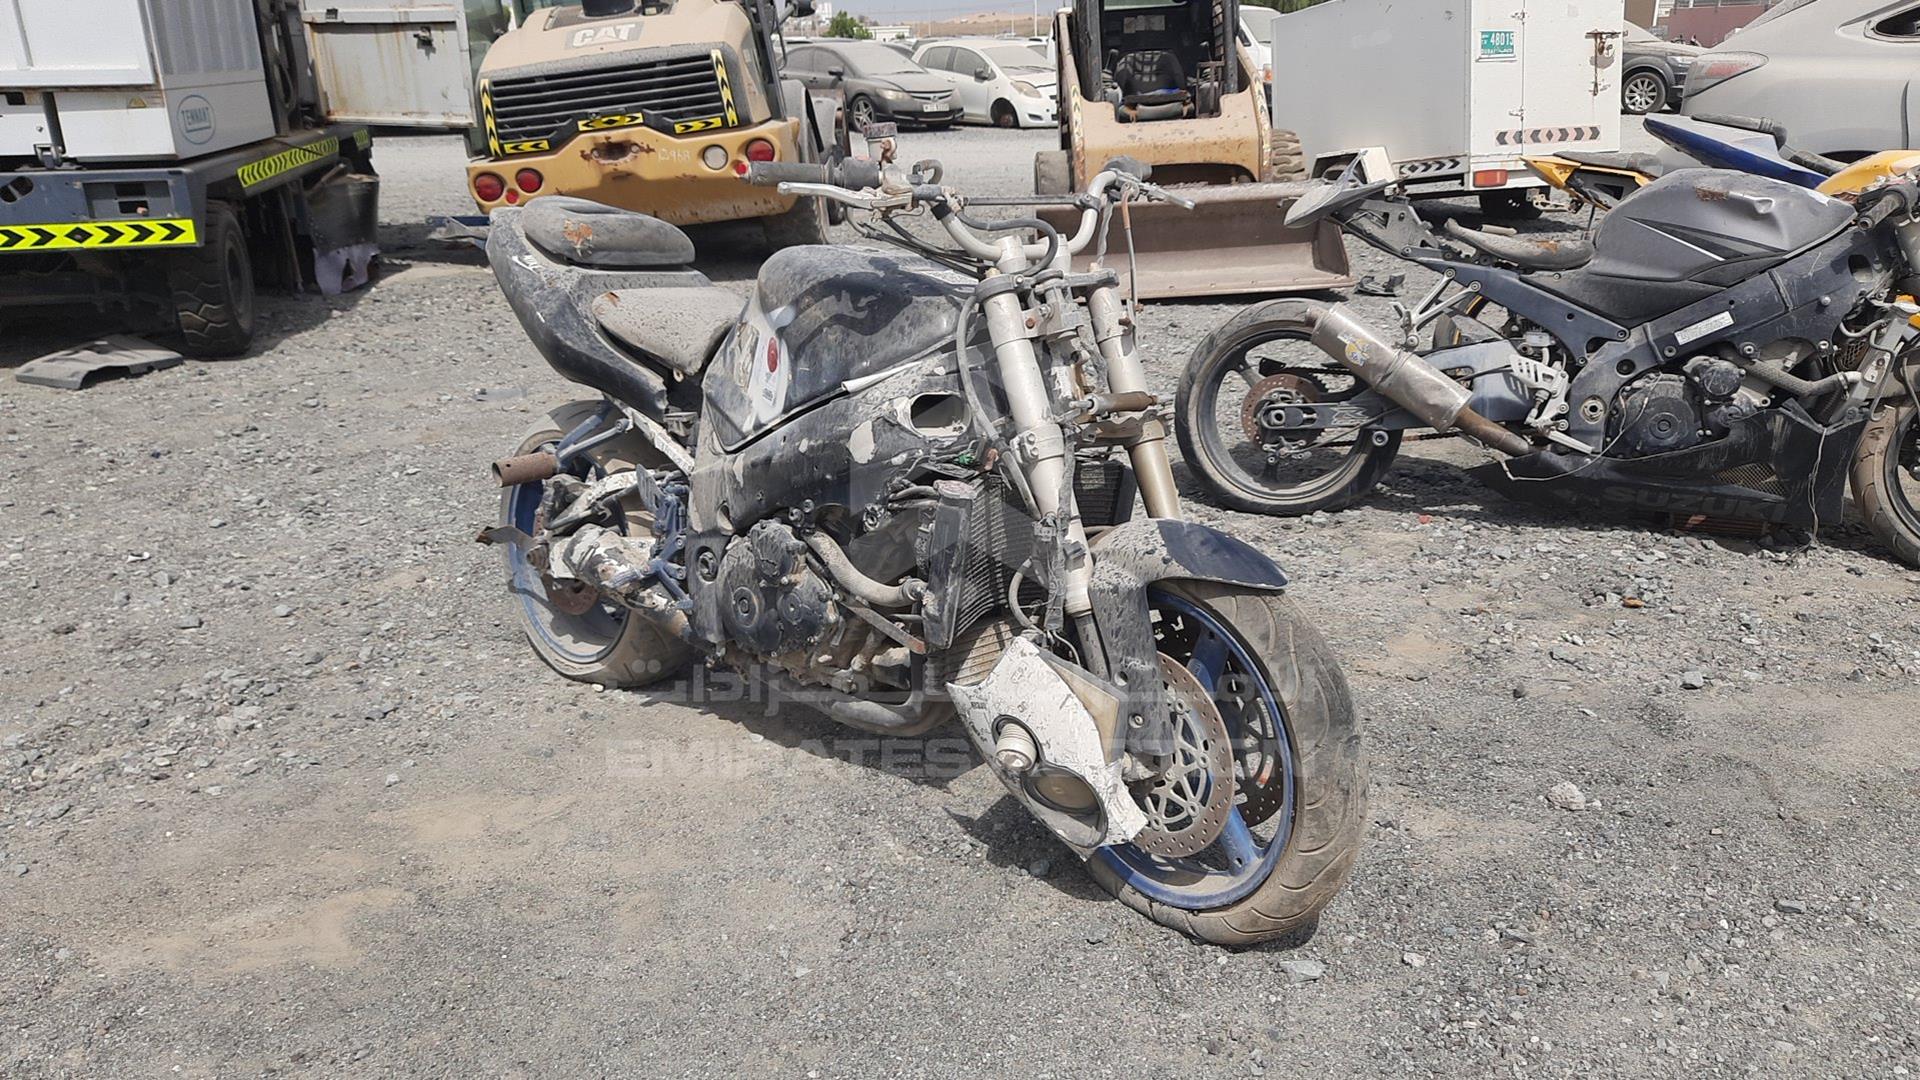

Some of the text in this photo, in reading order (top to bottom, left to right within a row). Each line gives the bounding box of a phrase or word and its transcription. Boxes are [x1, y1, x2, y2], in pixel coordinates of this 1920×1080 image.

[573, 24, 635, 47] CAT
[1491, 32, 1514, 46] 48015
[1602, 486, 1788, 522] SUZUKI
